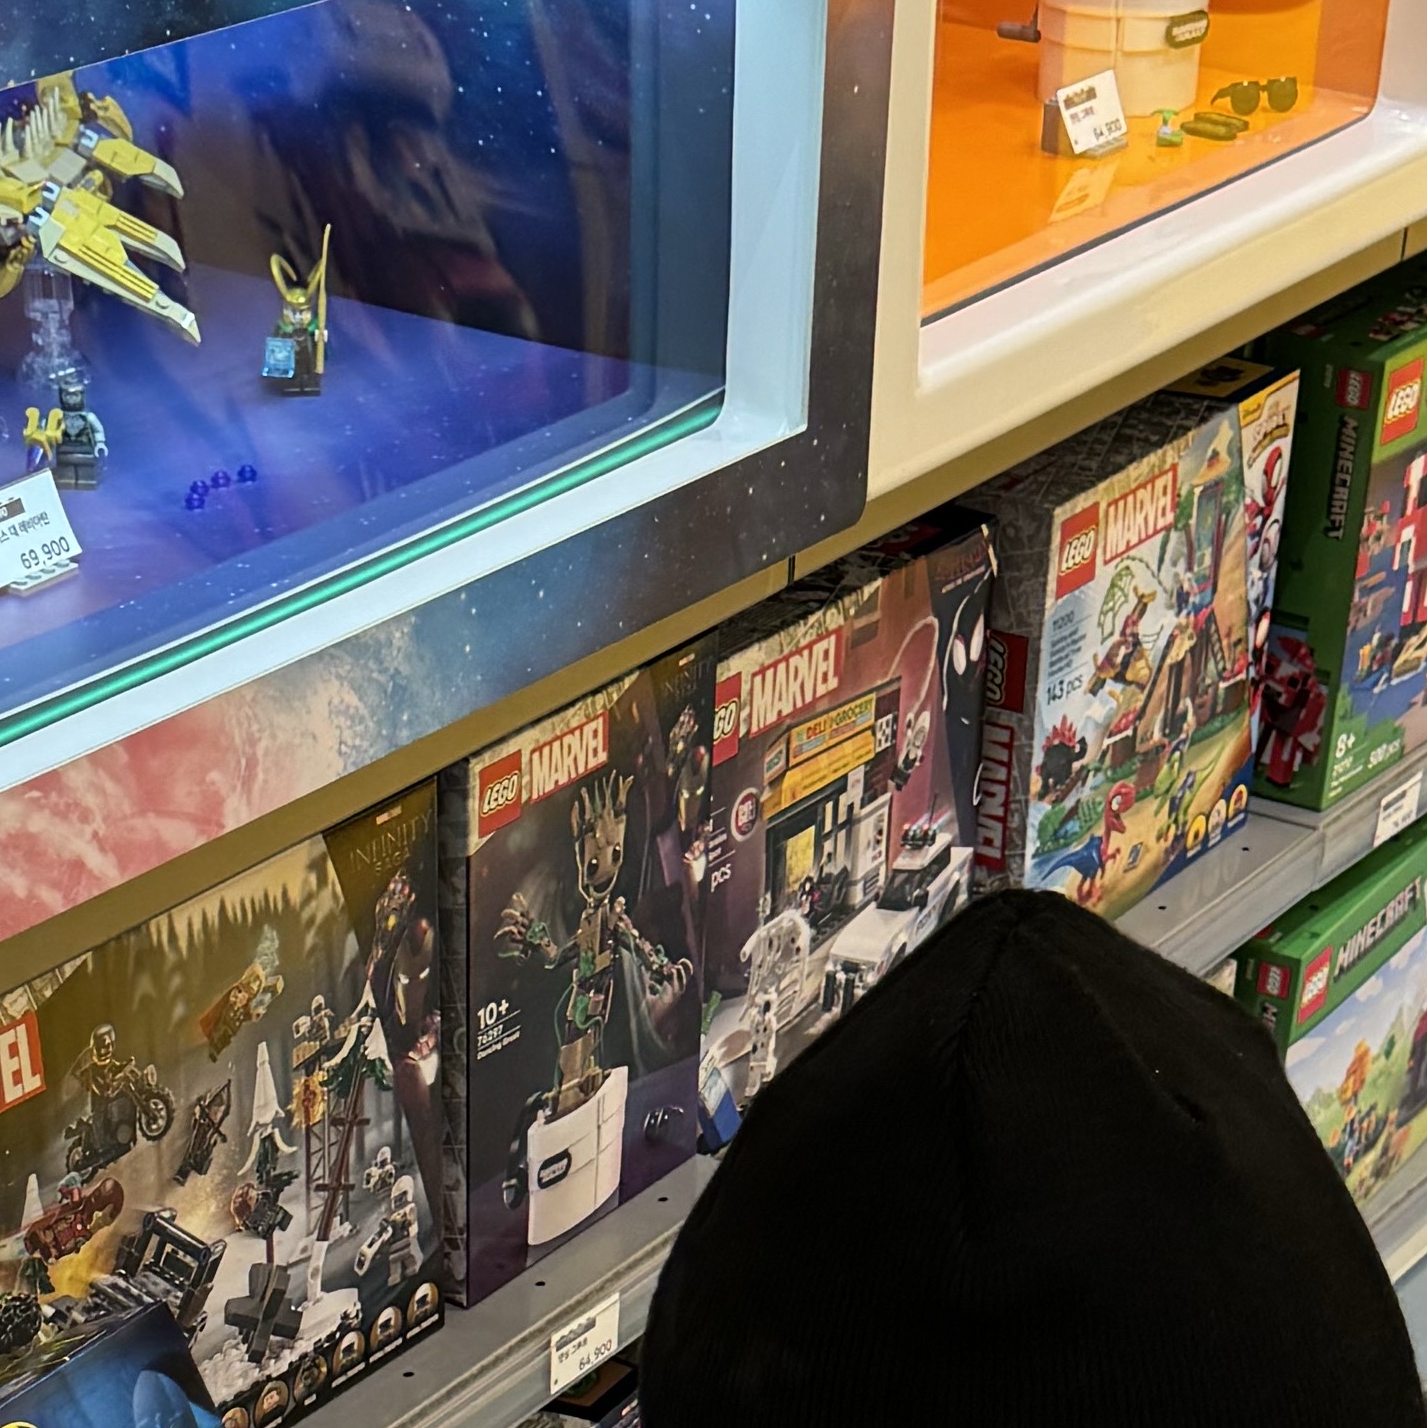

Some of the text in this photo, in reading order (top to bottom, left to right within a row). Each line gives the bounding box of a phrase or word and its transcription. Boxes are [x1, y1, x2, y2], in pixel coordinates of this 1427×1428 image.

[1345, 370, 1364, 407] LEGO
[1385, 378, 1421, 425] LEGO
[1326, 414, 1360, 541] MINECRAFT
[1105, 472, 1176, 562] MARVEL
[20, 536, 70, 569] 69,900
[1059, 526, 1097, 577] LEGO
[751, 633, 841, 737] MARVEL
[1045, 675, 1084, 705] 143 pcs
[713, 699, 739, 741] GO
[530, 715, 609, 803] MARVEL
[481, 771, 519, 816] LEGO
[1334, 875, 1422, 983] MINECRAFT
[477, 998, 510, 1030] 10+
[477, 1024, 504, 1047] 76297
[578, 1338, 612, 1371] 64,900
